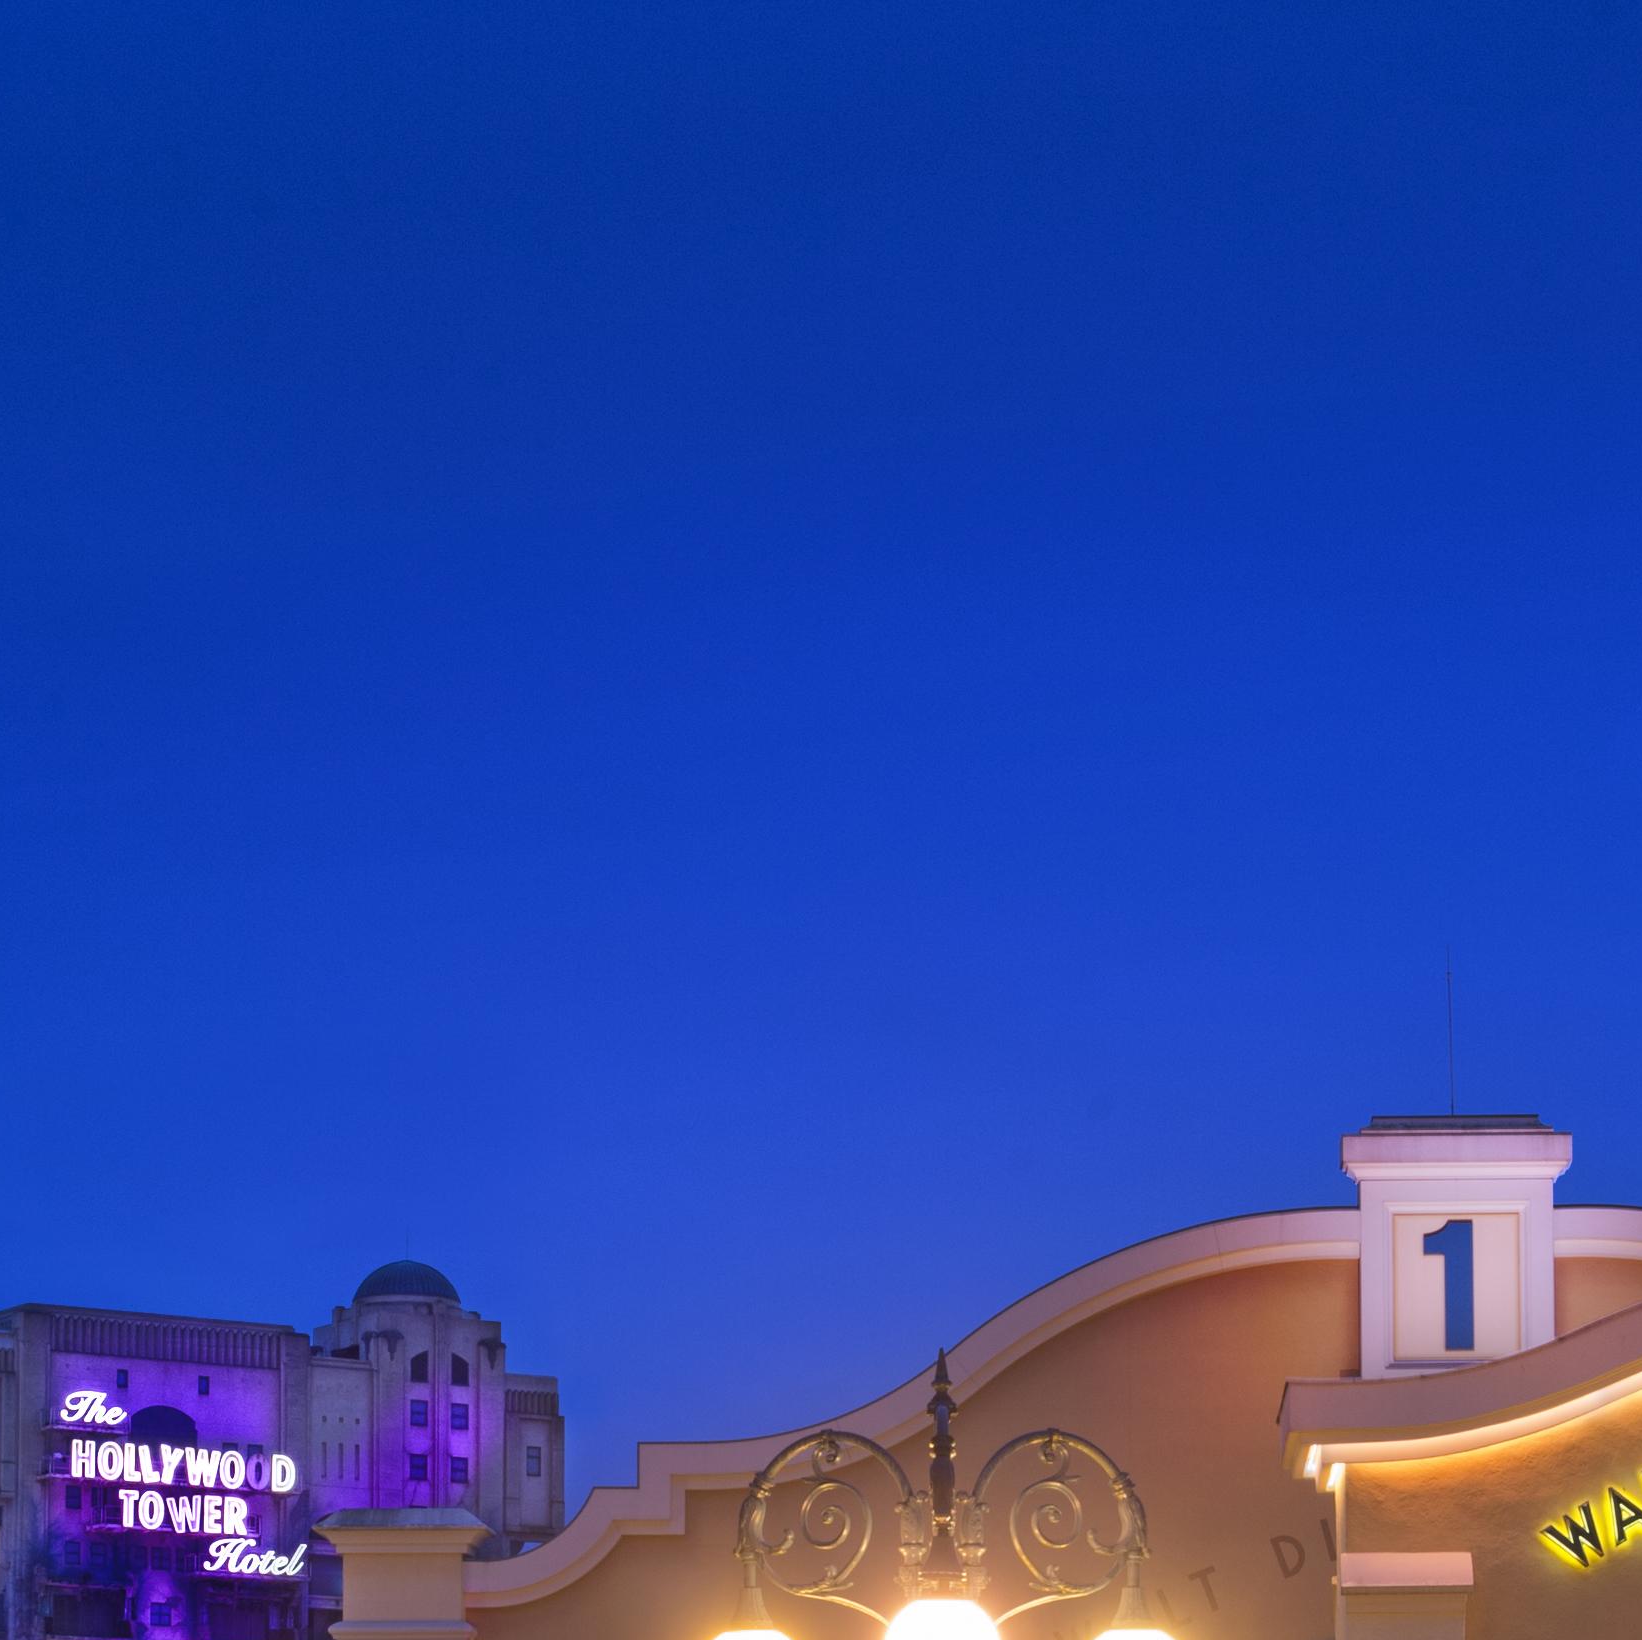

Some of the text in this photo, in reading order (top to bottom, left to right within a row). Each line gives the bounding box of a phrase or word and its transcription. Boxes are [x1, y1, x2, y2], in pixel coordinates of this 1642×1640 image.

[1423, 1219, 1475, 1351] 1
[60, 1390, 128, 1426] The
[70, 1438, 297, 1494] HOLLYWOOD
[118, 1488, 249, 1536] TOWER
[203, 1538, 308, 1577] Hotel
